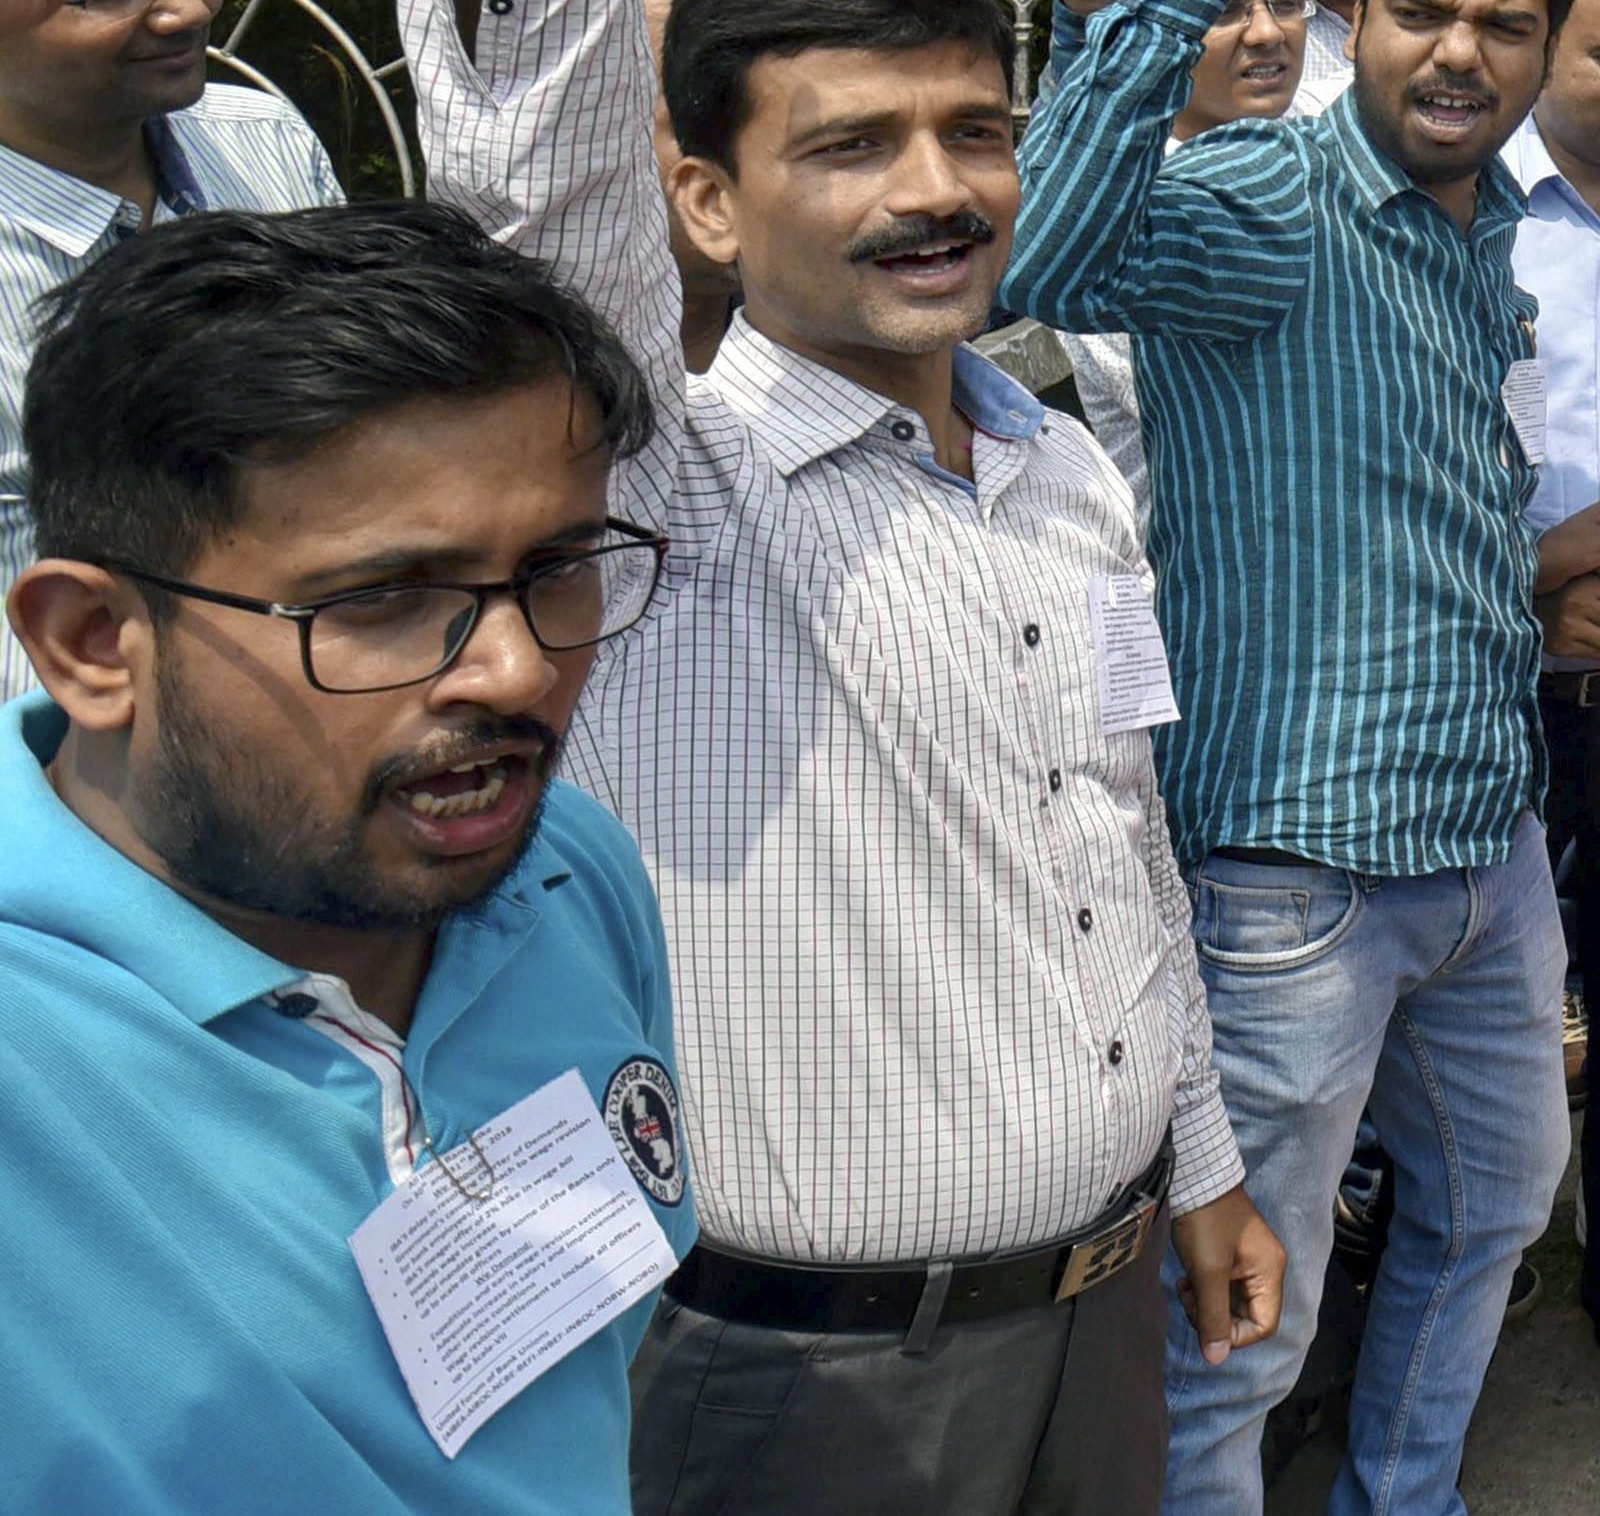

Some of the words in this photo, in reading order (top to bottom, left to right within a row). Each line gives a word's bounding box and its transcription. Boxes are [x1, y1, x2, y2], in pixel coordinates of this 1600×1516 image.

[522, 1116, 568, 1150] Demands
[528, 1141, 555, 1162] wage
[553, 1116, 591, 1144] revision
[532, 1166, 559, 1187] wage
[437, 1253, 474, 1286] mandate
[472, 1234, 499, 1259] given
[512, 1208, 538, 1228] some
[566, 1168, 595, 1191] Banks
[594, 1155, 617, 1174] only
[460, 1221, 497, 1251] increase
[467, 1321, 501, 1353] revision
[499, 1285, 549, 1325] settlement
[560, 1252, 596, 1280] include
[607, 1220, 641, 1247] officers
[471, 1287, 508, 1319] increase
[545, 1245, 566, 1263] and
[565, 1202, 627, 1249] improvement
[472, 1284, 491, 1302] and
[514, 1250, 540, 1272] wage
[539, 1223, 577, 1252] revision
[461, 1315, 490, 1342] service
[489, 1279, 536, 1318] conditions
[494, 1353, 517, 1374] Bank
